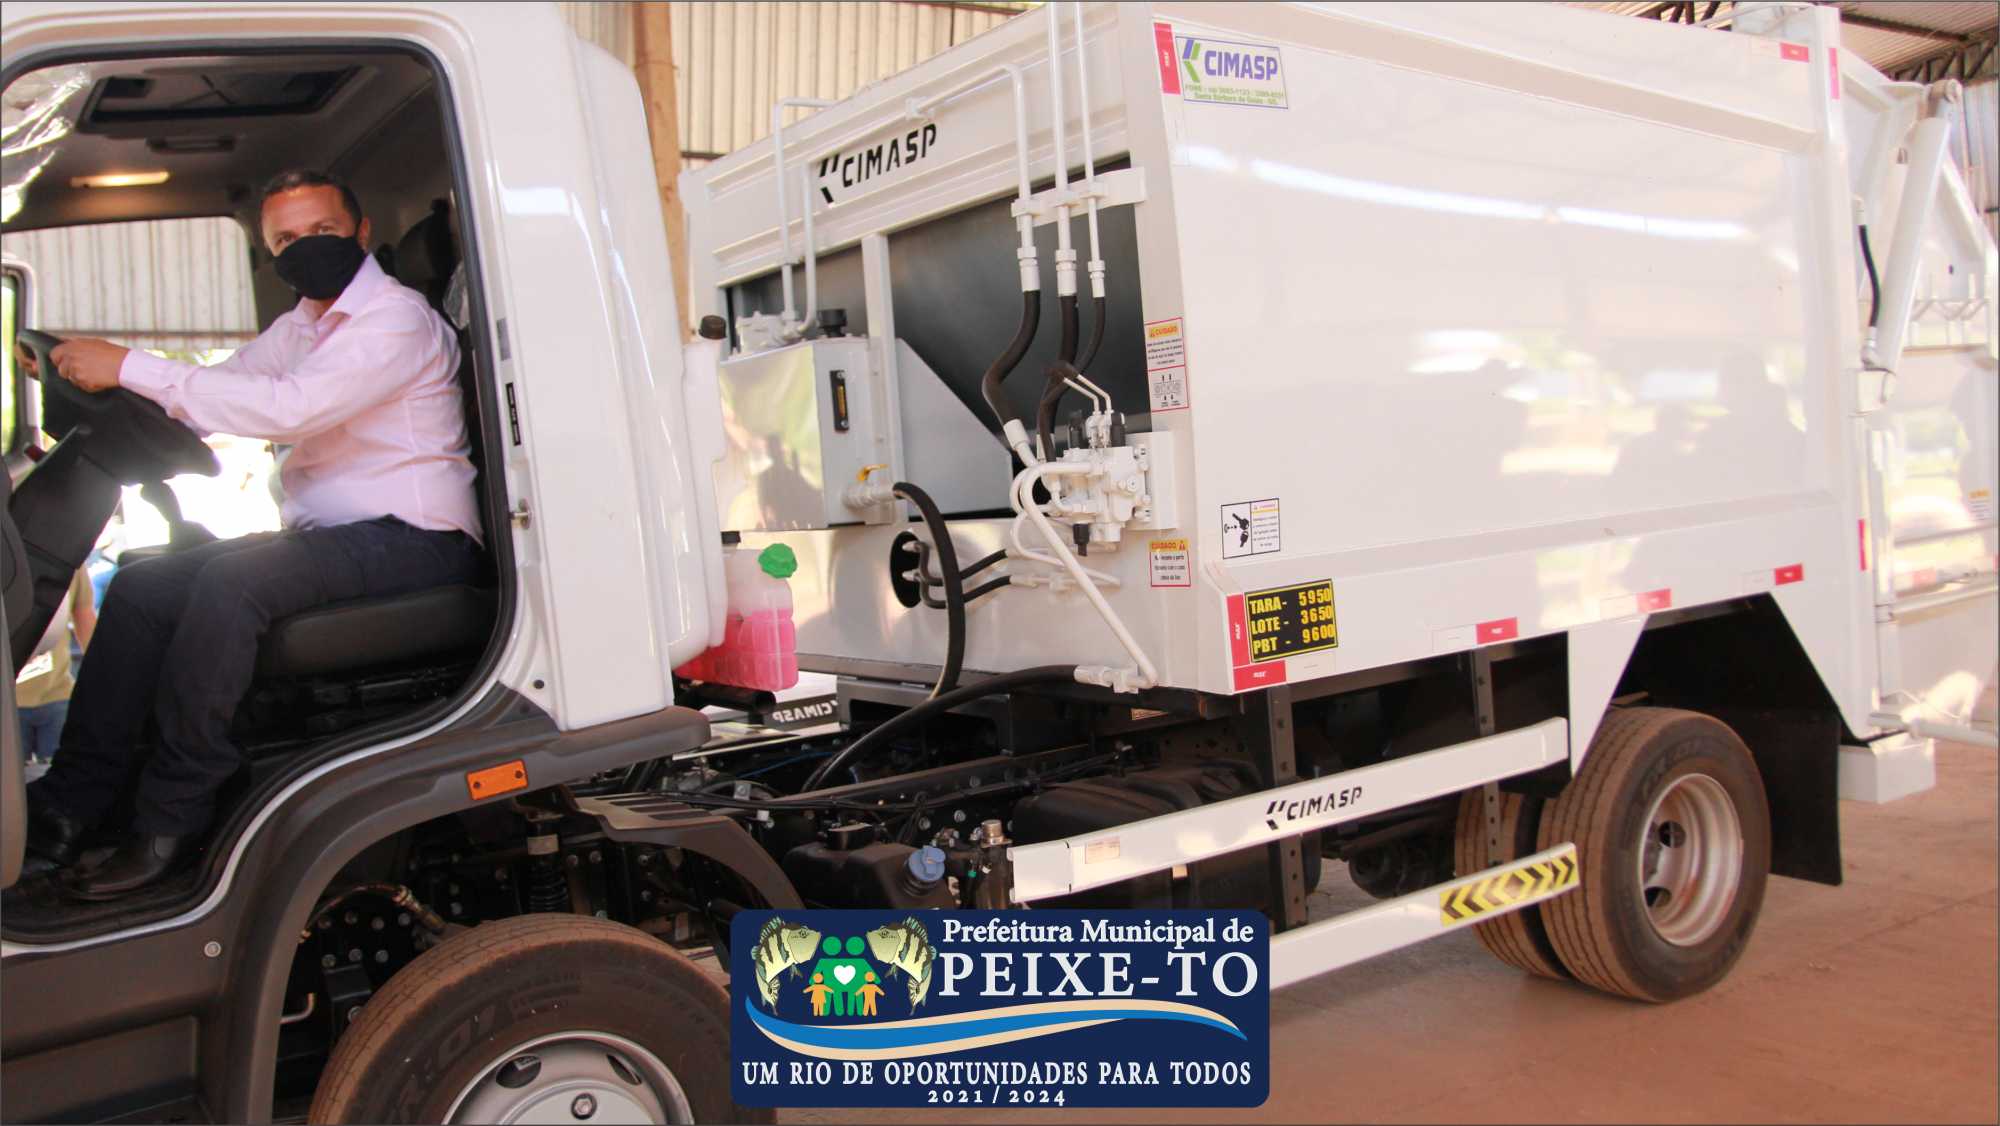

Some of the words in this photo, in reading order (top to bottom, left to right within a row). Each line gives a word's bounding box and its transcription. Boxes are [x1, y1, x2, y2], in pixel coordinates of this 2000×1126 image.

[1204, 50, 1278, 81] CIMASP
[1185, 84, 1203, 92] FONE
[1194, 91, 1212, 100] Santa
[842, 123, 937, 188] CIMASP
[1155, 326, 1177, 335] CUIDADO
[1298, 588, 1332, 606] 5950
[1251, 616, 1281, 635] LOTE
[1300, 605, 1334, 624] 3650
[1253, 636, 1278, 655] PBT
[1302, 624, 1335, 643] 9600
[1286, 786, 1363, 821] CIMASP
